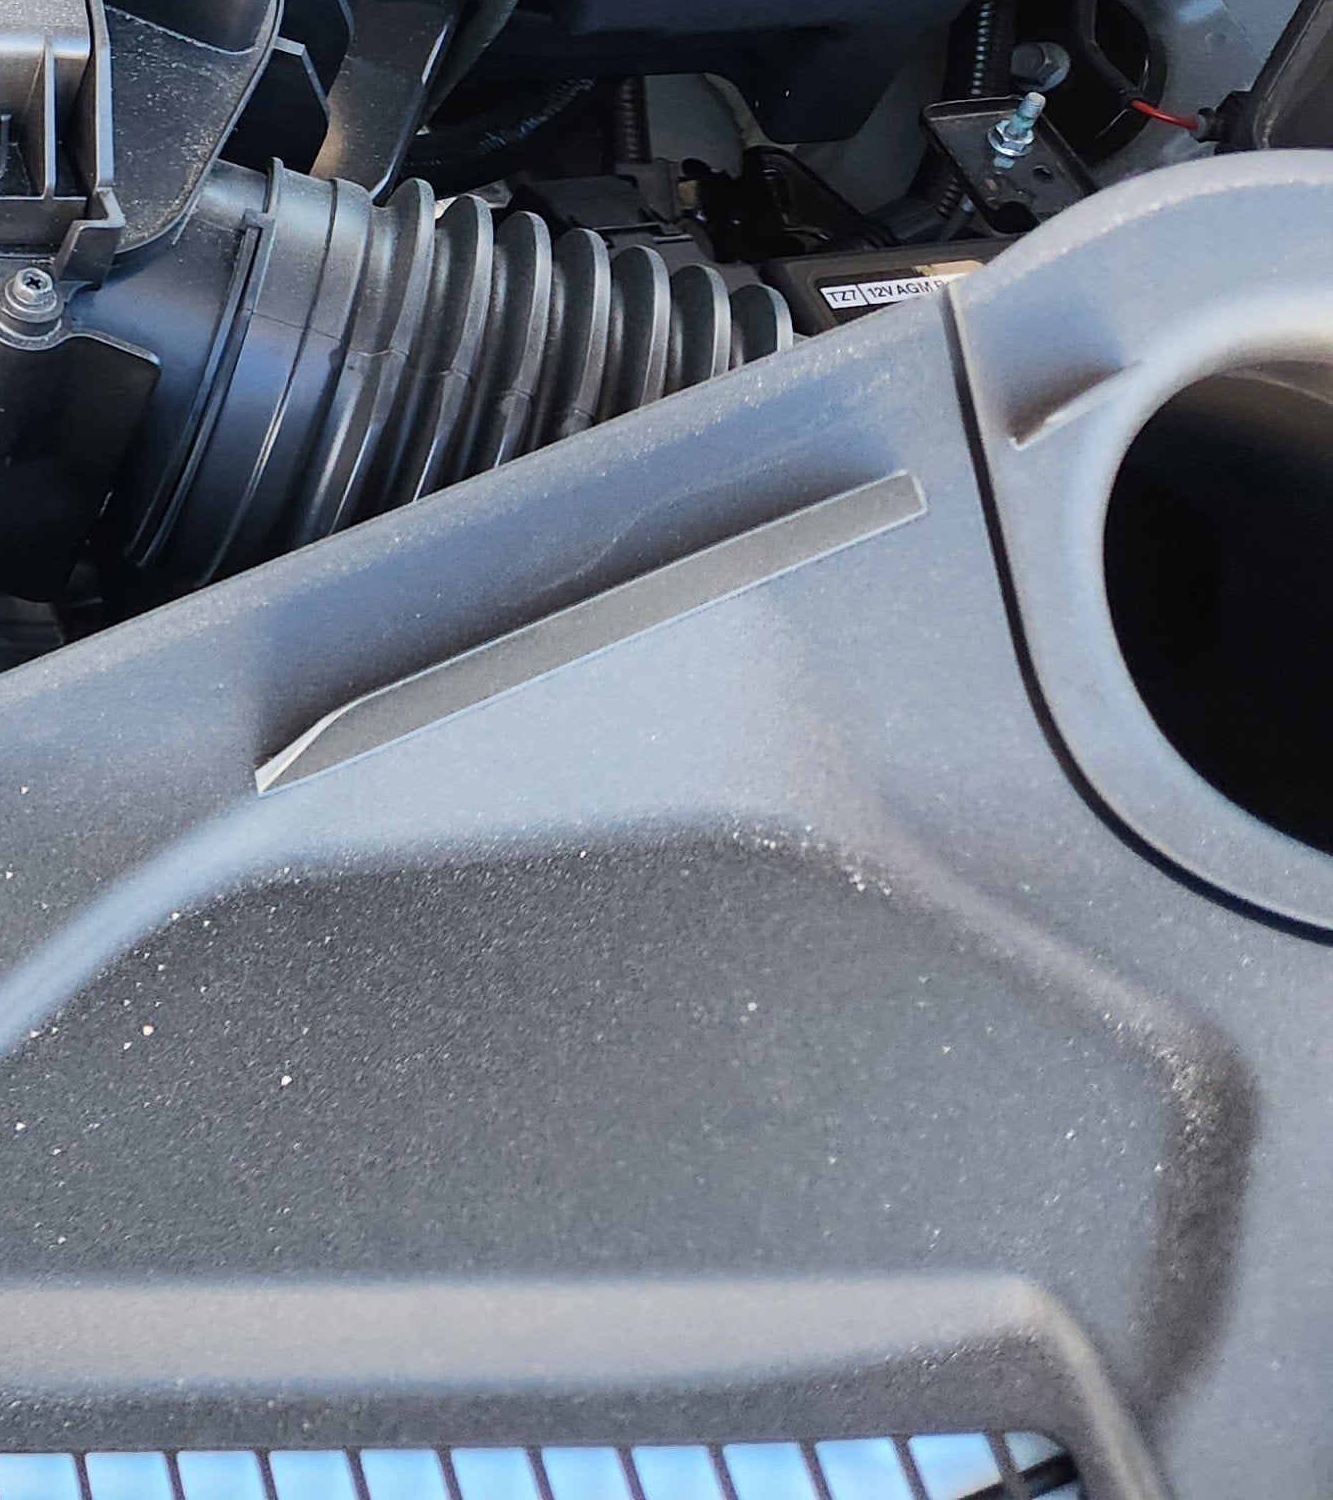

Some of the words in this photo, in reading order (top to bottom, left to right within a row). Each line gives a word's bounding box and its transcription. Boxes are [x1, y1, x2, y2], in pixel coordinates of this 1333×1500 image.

[826, 288, 857, 303] TZ7
[867, 285, 894, 299] 12V
[897, 280, 933, 295] AGM
